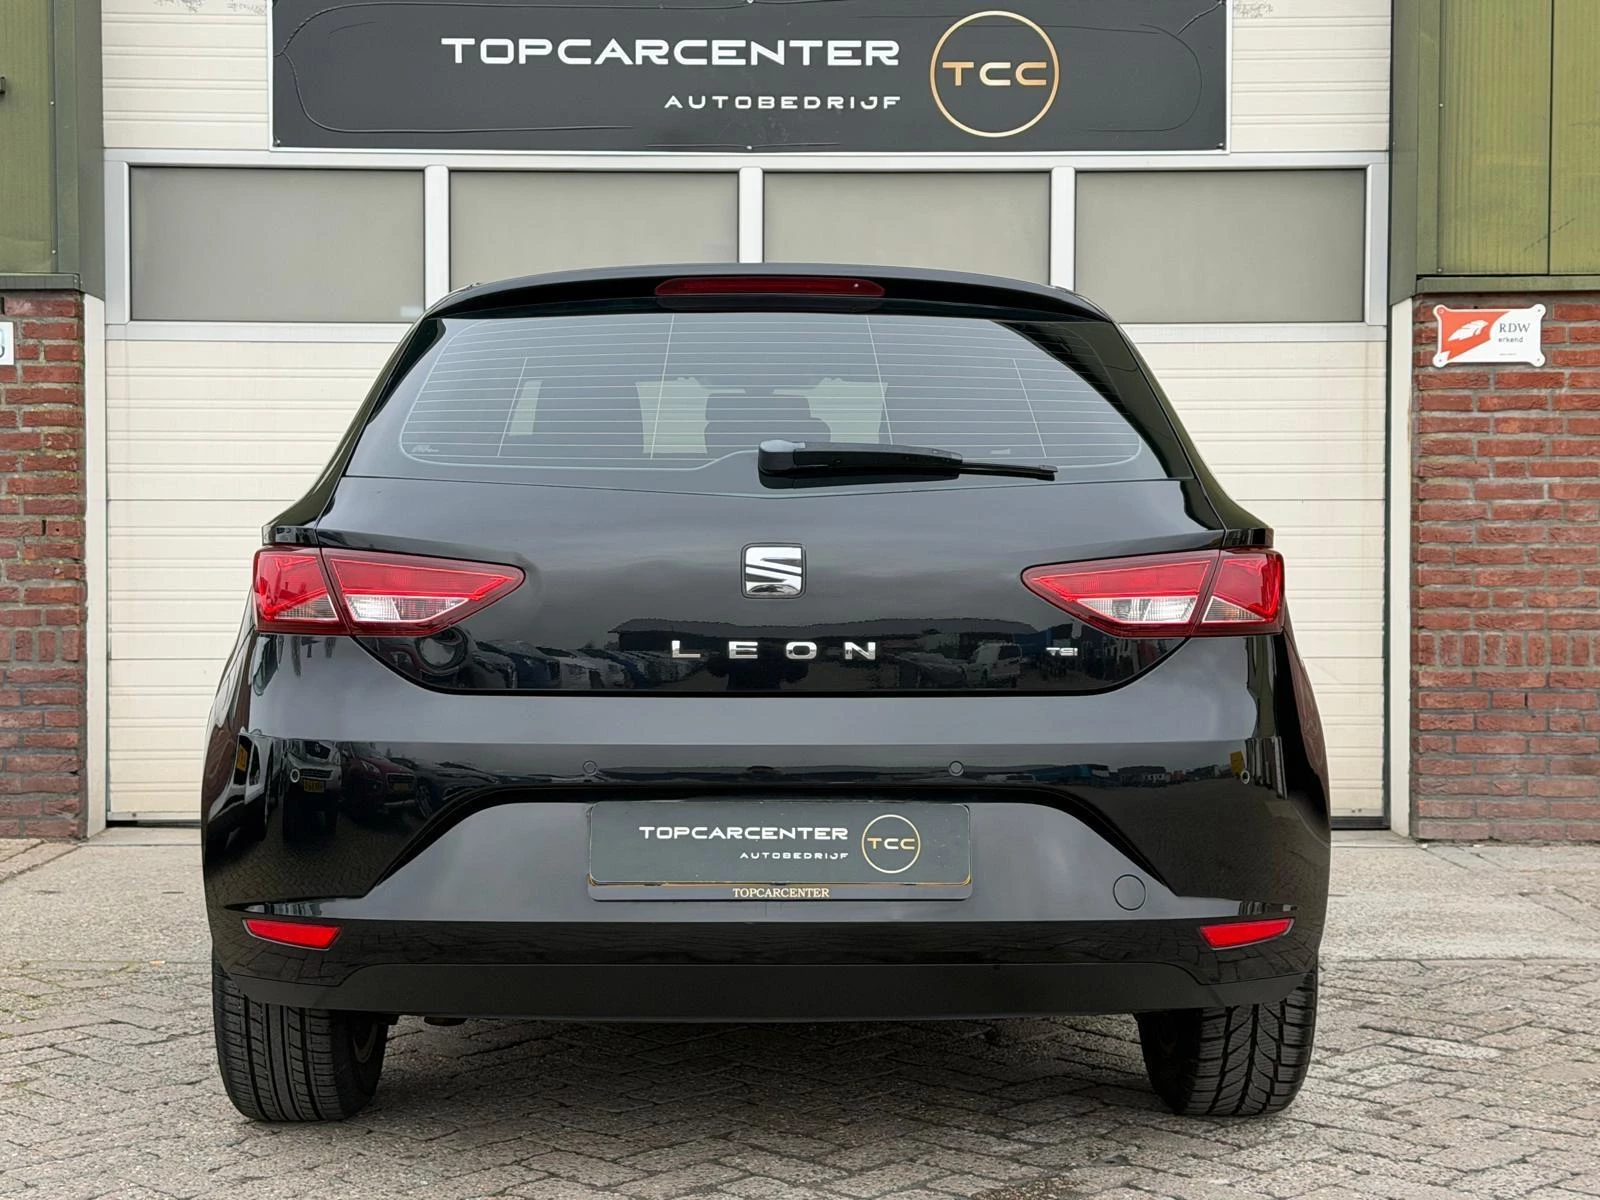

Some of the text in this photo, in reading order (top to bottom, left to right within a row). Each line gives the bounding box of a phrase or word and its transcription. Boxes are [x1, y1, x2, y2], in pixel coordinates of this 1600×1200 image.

[441, 37, 899, 66] TOPCARCENTER
[942, 61, 1047, 86] TCC
[664, 95, 901, 110] AUTOBEDRIJF
[1499, 322, 1531, 333] RDW
[671, 640, 877, 660] LEON
[1046, 647, 1078, 656] TSI
[639, 826, 848, 840] TOPCARCENTER
[867, 837, 915, 850] TCC
[740, 852, 848, 860] AUTOBEDRIJF
[732, 887, 830, 898] TOPCARCENTER
